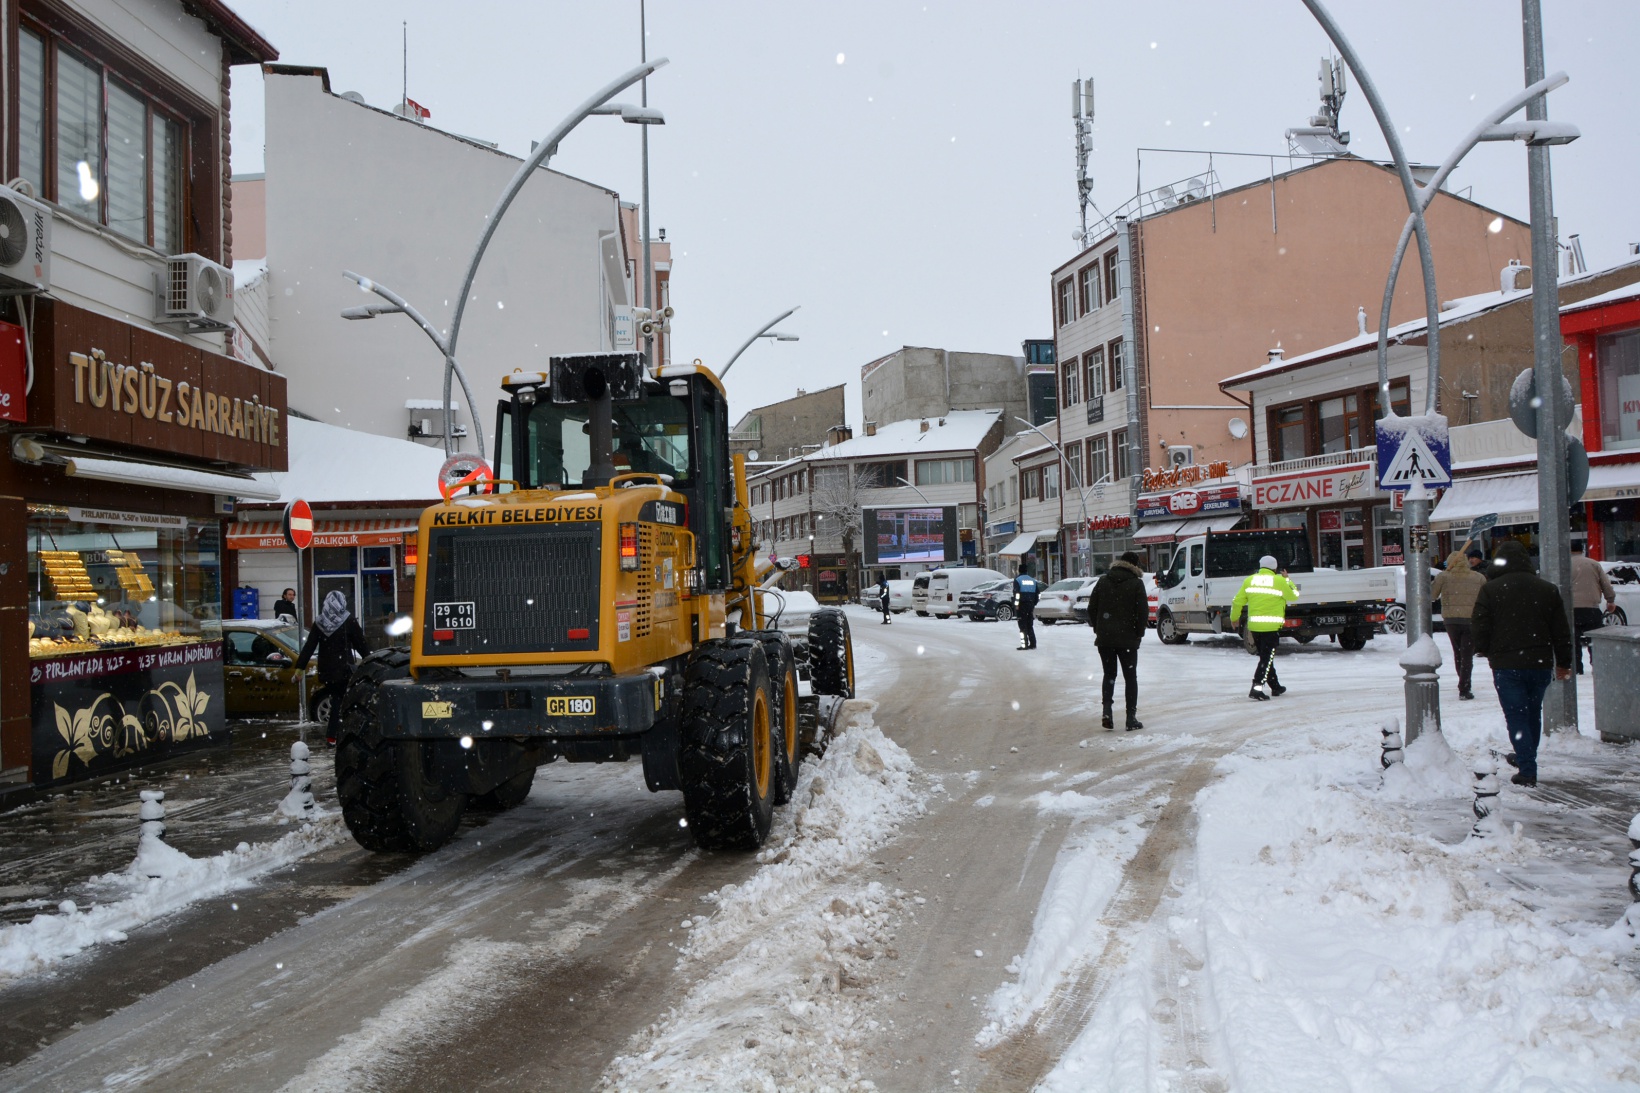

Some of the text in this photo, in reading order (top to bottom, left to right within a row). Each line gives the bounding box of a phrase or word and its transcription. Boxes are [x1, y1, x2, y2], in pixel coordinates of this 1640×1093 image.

[35, 211, 44, 263] arçelik
[69, 348, 279, 446] TÜYSÜZ SARRAFİYE
[1256, 471, 1366, 505] ECZANE Eylül
[1170, 493, 1197, 511] ENES
[1204, 501, 1229, 511] ŞEKERLEME
[80, 509, 121, 521] PIRLANTADA
[140, 515, 160, 523] VARAN
[434, 504, 603, 526] KELKİT BELEDİYESİ
[259, 537, 287, 547] MEYDA
[314, 535, 359, 548] BALIKÇILIK
[437, 605, 471, 616] 29 01
[445, 617, 472, 628] 1610
[45, 660, 103, 679] PIRLANTADA
[106, 656, 125, 672] %25
[138, 654, 157, 670] %35
[158, 651, 183, 667] VARAN
[182, 644, 214, 665] İNDİRİM
[549, 699, 592, 713] GR 180
